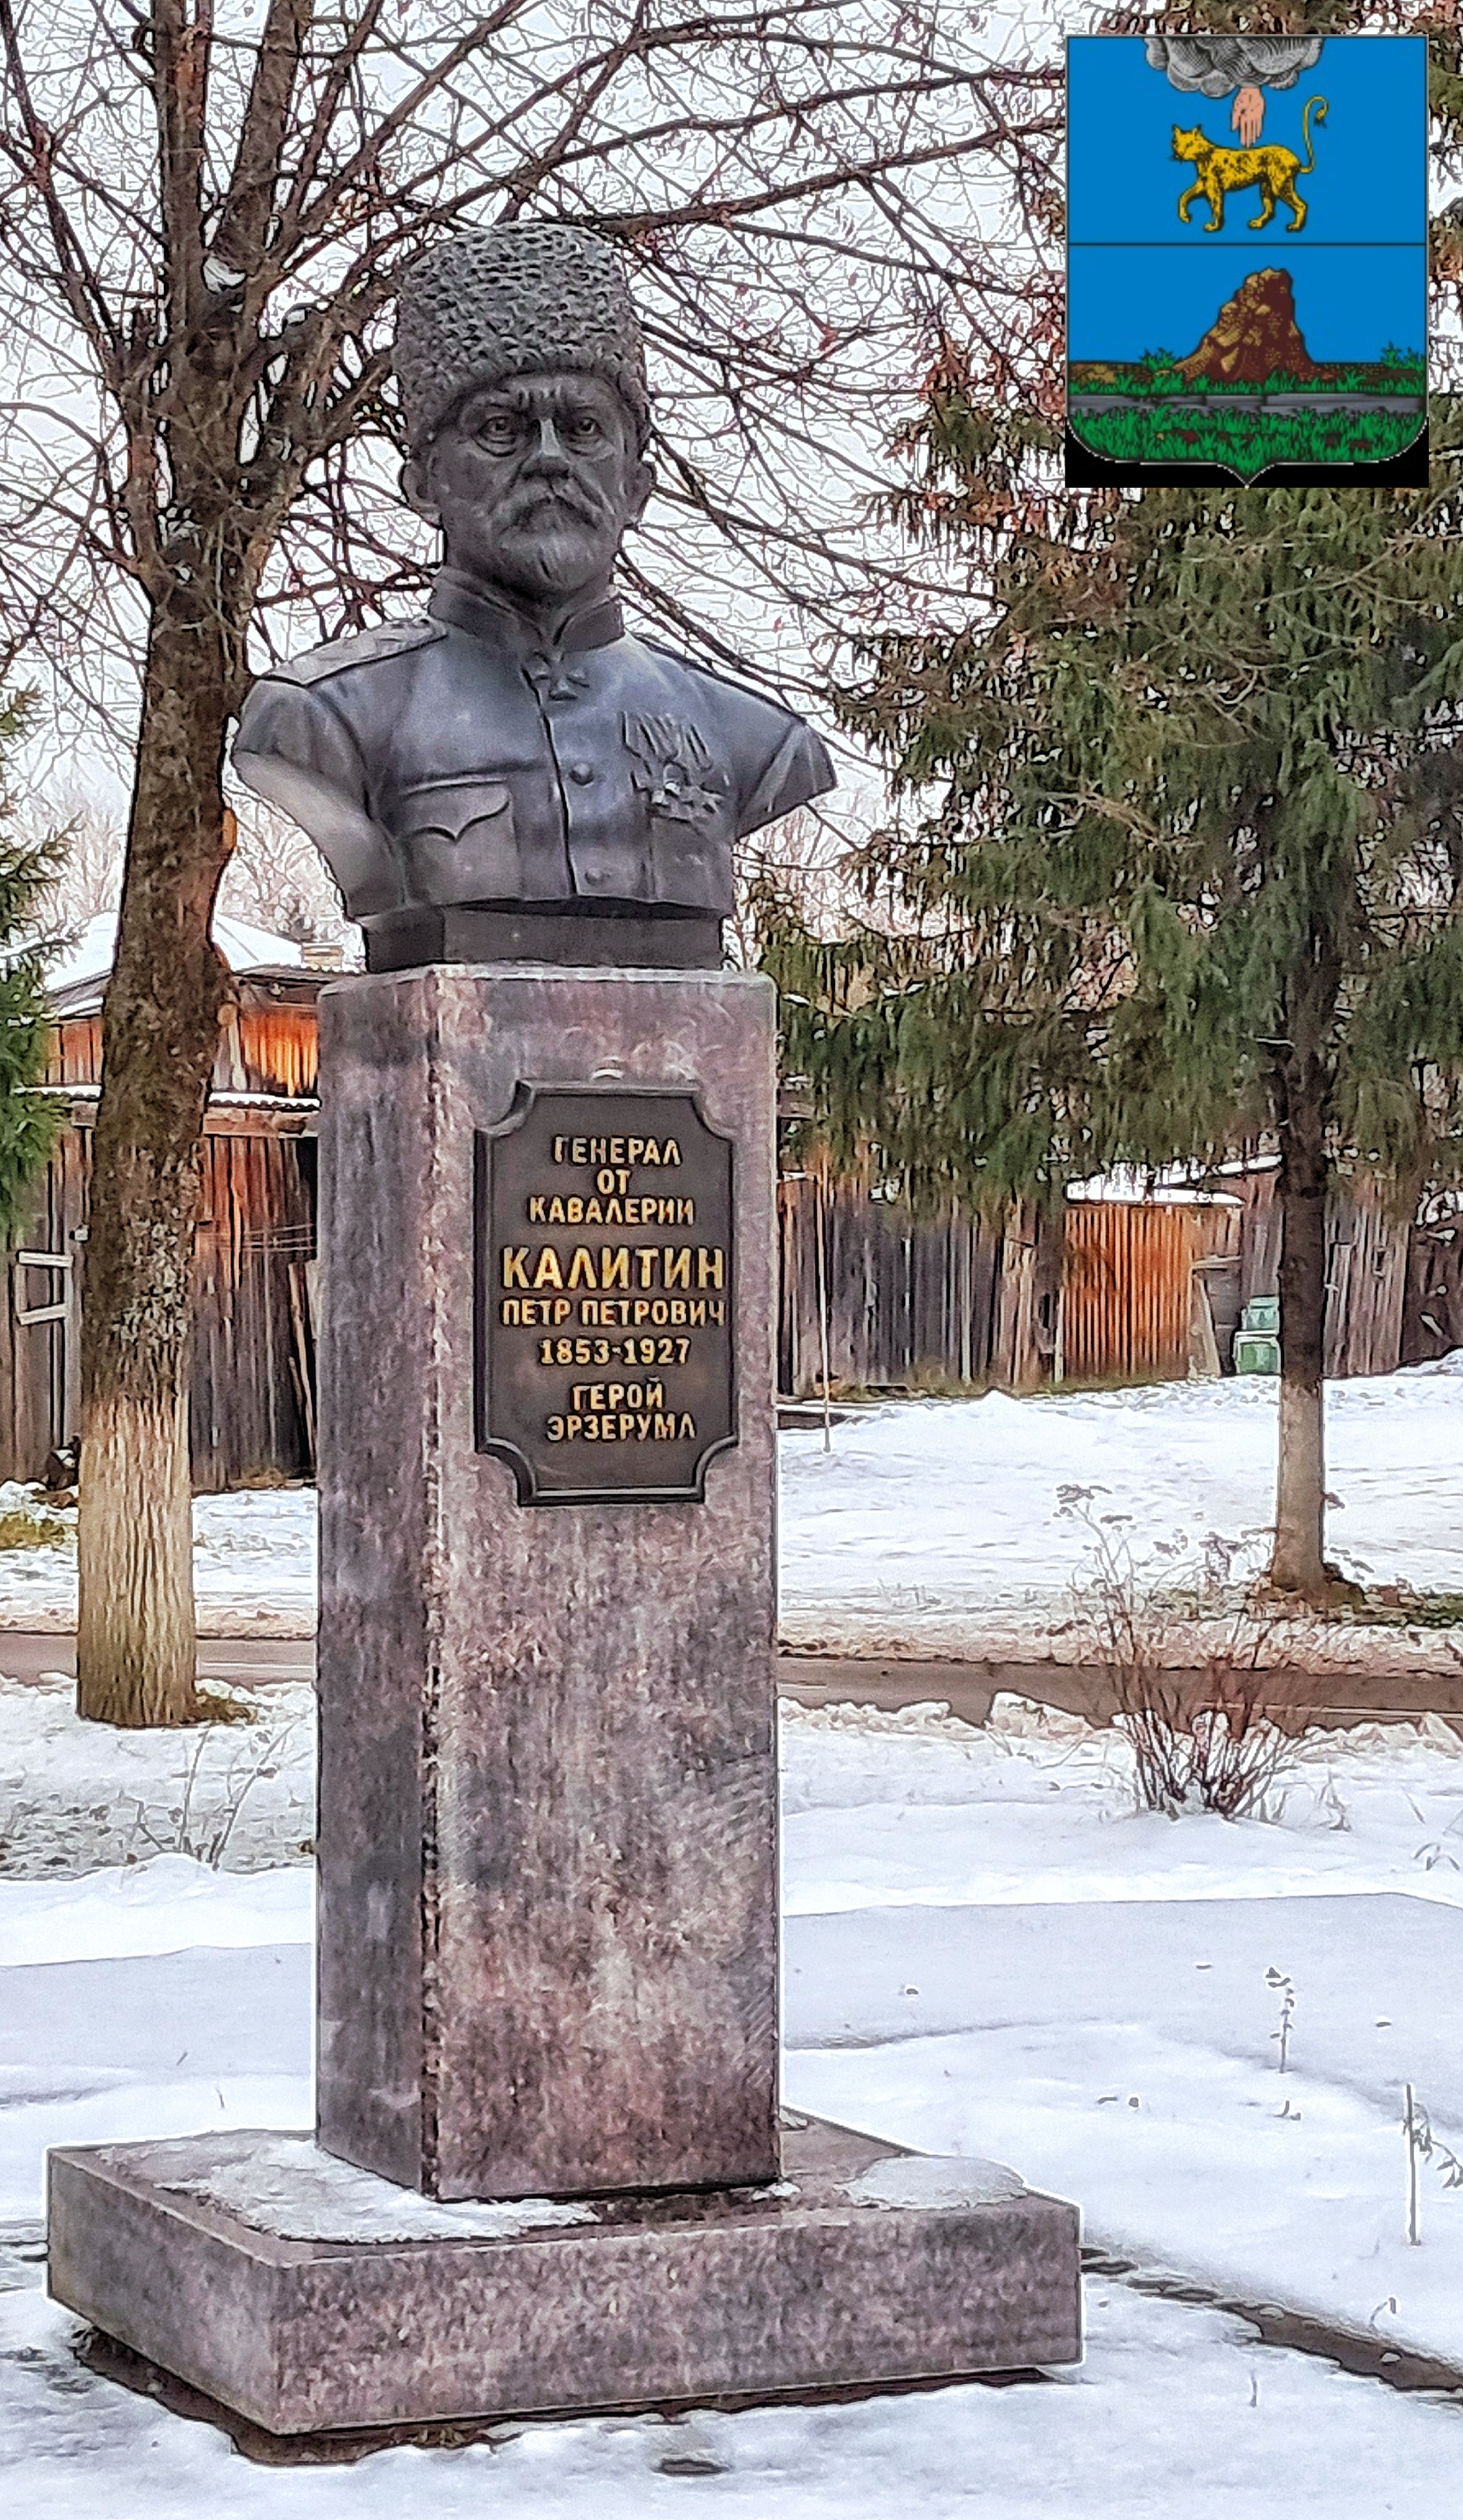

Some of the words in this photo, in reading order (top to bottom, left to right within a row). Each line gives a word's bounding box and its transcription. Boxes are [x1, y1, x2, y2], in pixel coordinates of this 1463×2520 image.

[554, 1136, 682, 1165] ГЕНЕРАЛ
[597, 1169, 631, 1195] ОТ
[529, 1196, 694, 1226] КАВАЛЕРИИ
[502, 1247, 724, 1290] КАЛИТИН
[502, 1299, 571, 1325] ПЕТР
[582, 1299, 726, 1327] ПЕТРОВИЧ
[539, 1338, 691, 1364] 1853-1927
[572, 1376, 664, 1411] ГЕРОЙ
